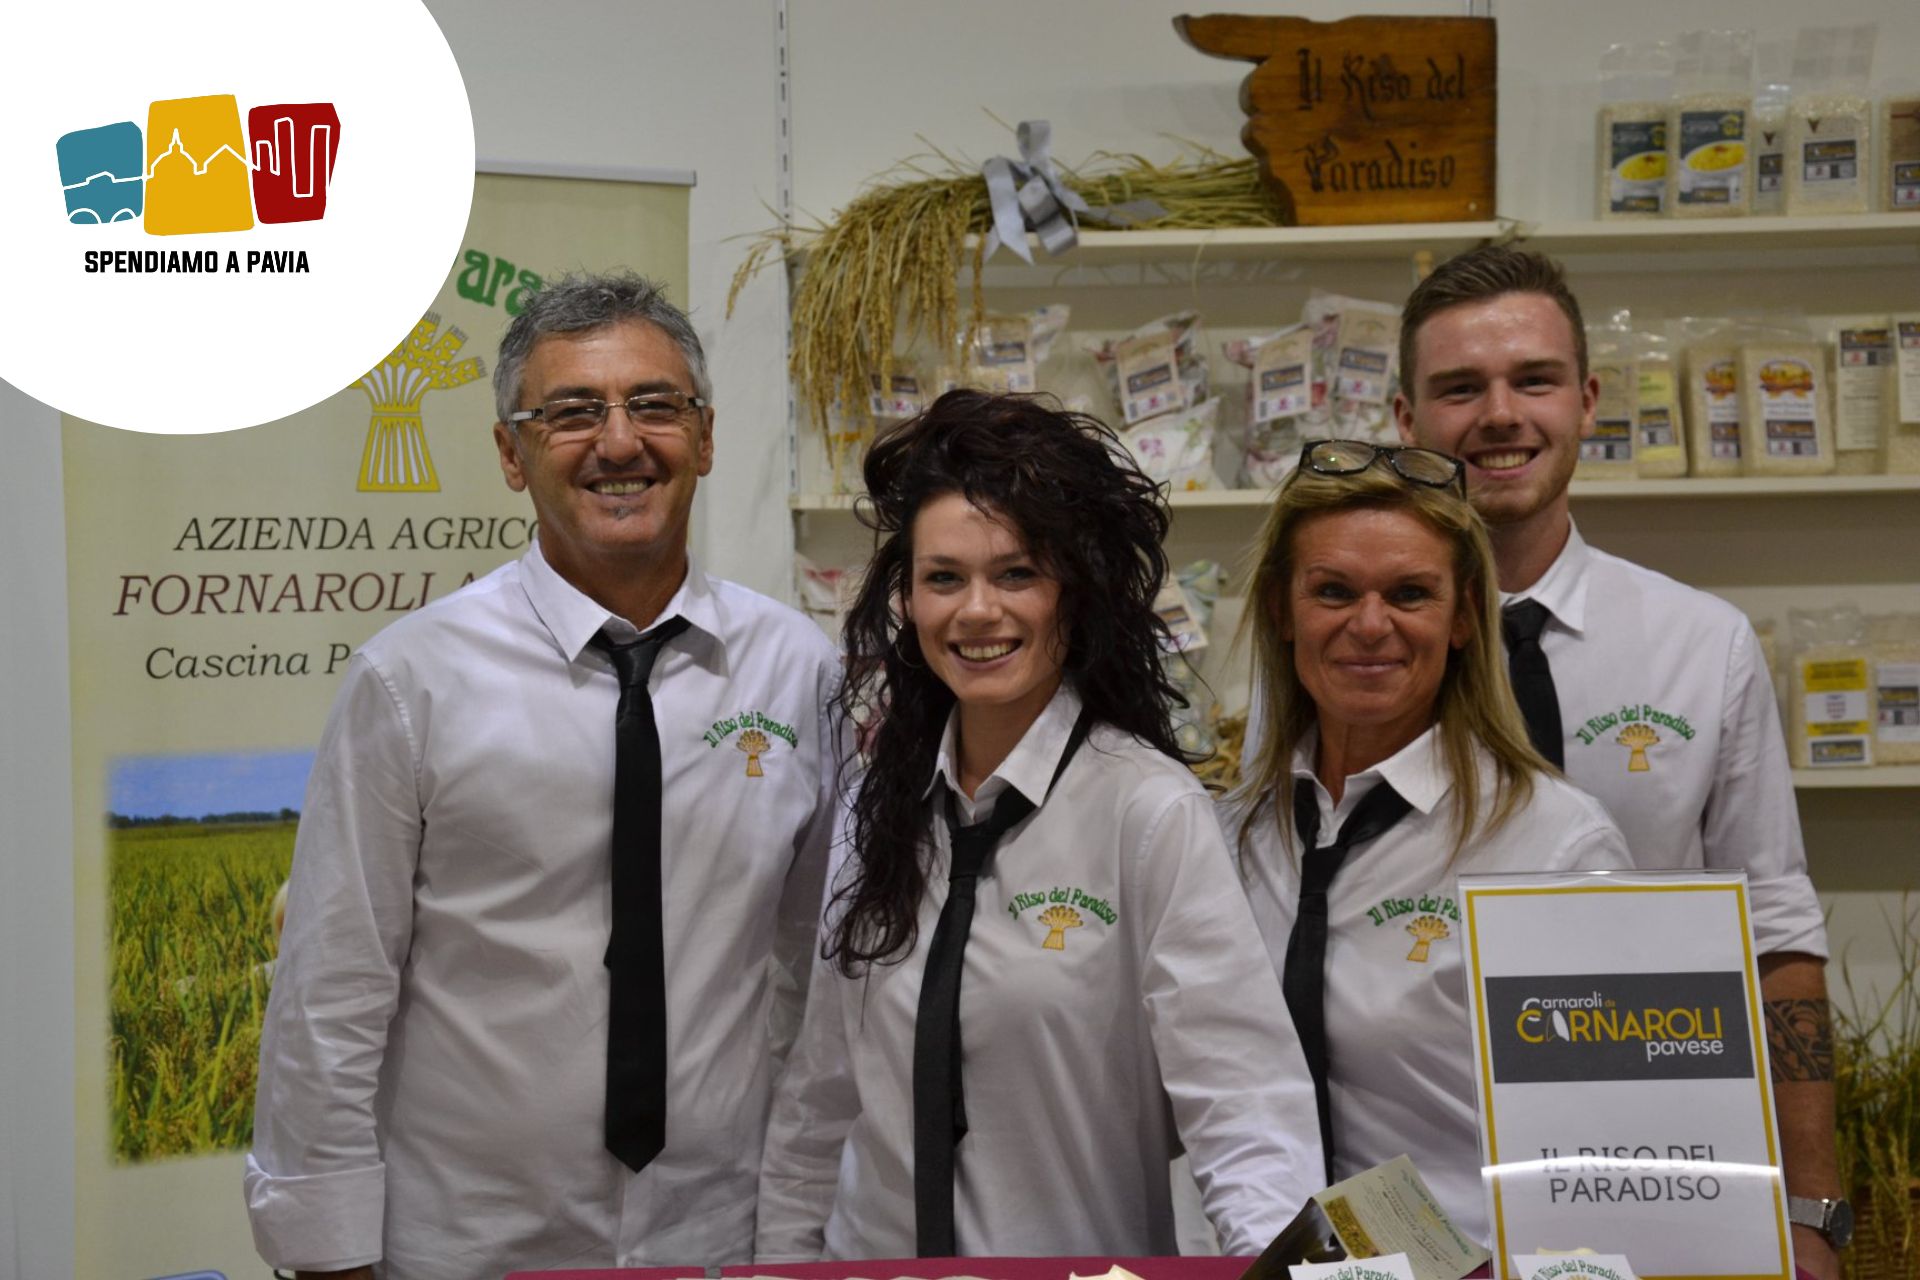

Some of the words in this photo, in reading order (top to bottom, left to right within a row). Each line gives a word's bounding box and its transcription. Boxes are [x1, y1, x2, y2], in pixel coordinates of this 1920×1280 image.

[1297, 48, 1322, 111] Il
[1341, 54, 1411, 121] Riso
[1427, 53, 1466, 100] del
[1295, 136, 1456, 192] Paradiso
[173, 517, 377, 551] AZIENDA
[112, 572, 436, 616] FORNAROLI
[145, 644, 310, 679] Cascina
[323, 643, 352, 675] P
[739, 711, 754, 728] del
[1621, 704, 1639, 722] del
[1049, 886, 1070, 903] del
[1419, 893, 1440, 913] del
[1521, 991, 1602, 1014] Carnaroli
[1645, 1039, 1724, 1062] pavese
[1549, 1174, 1721, 1203] PARADISO
